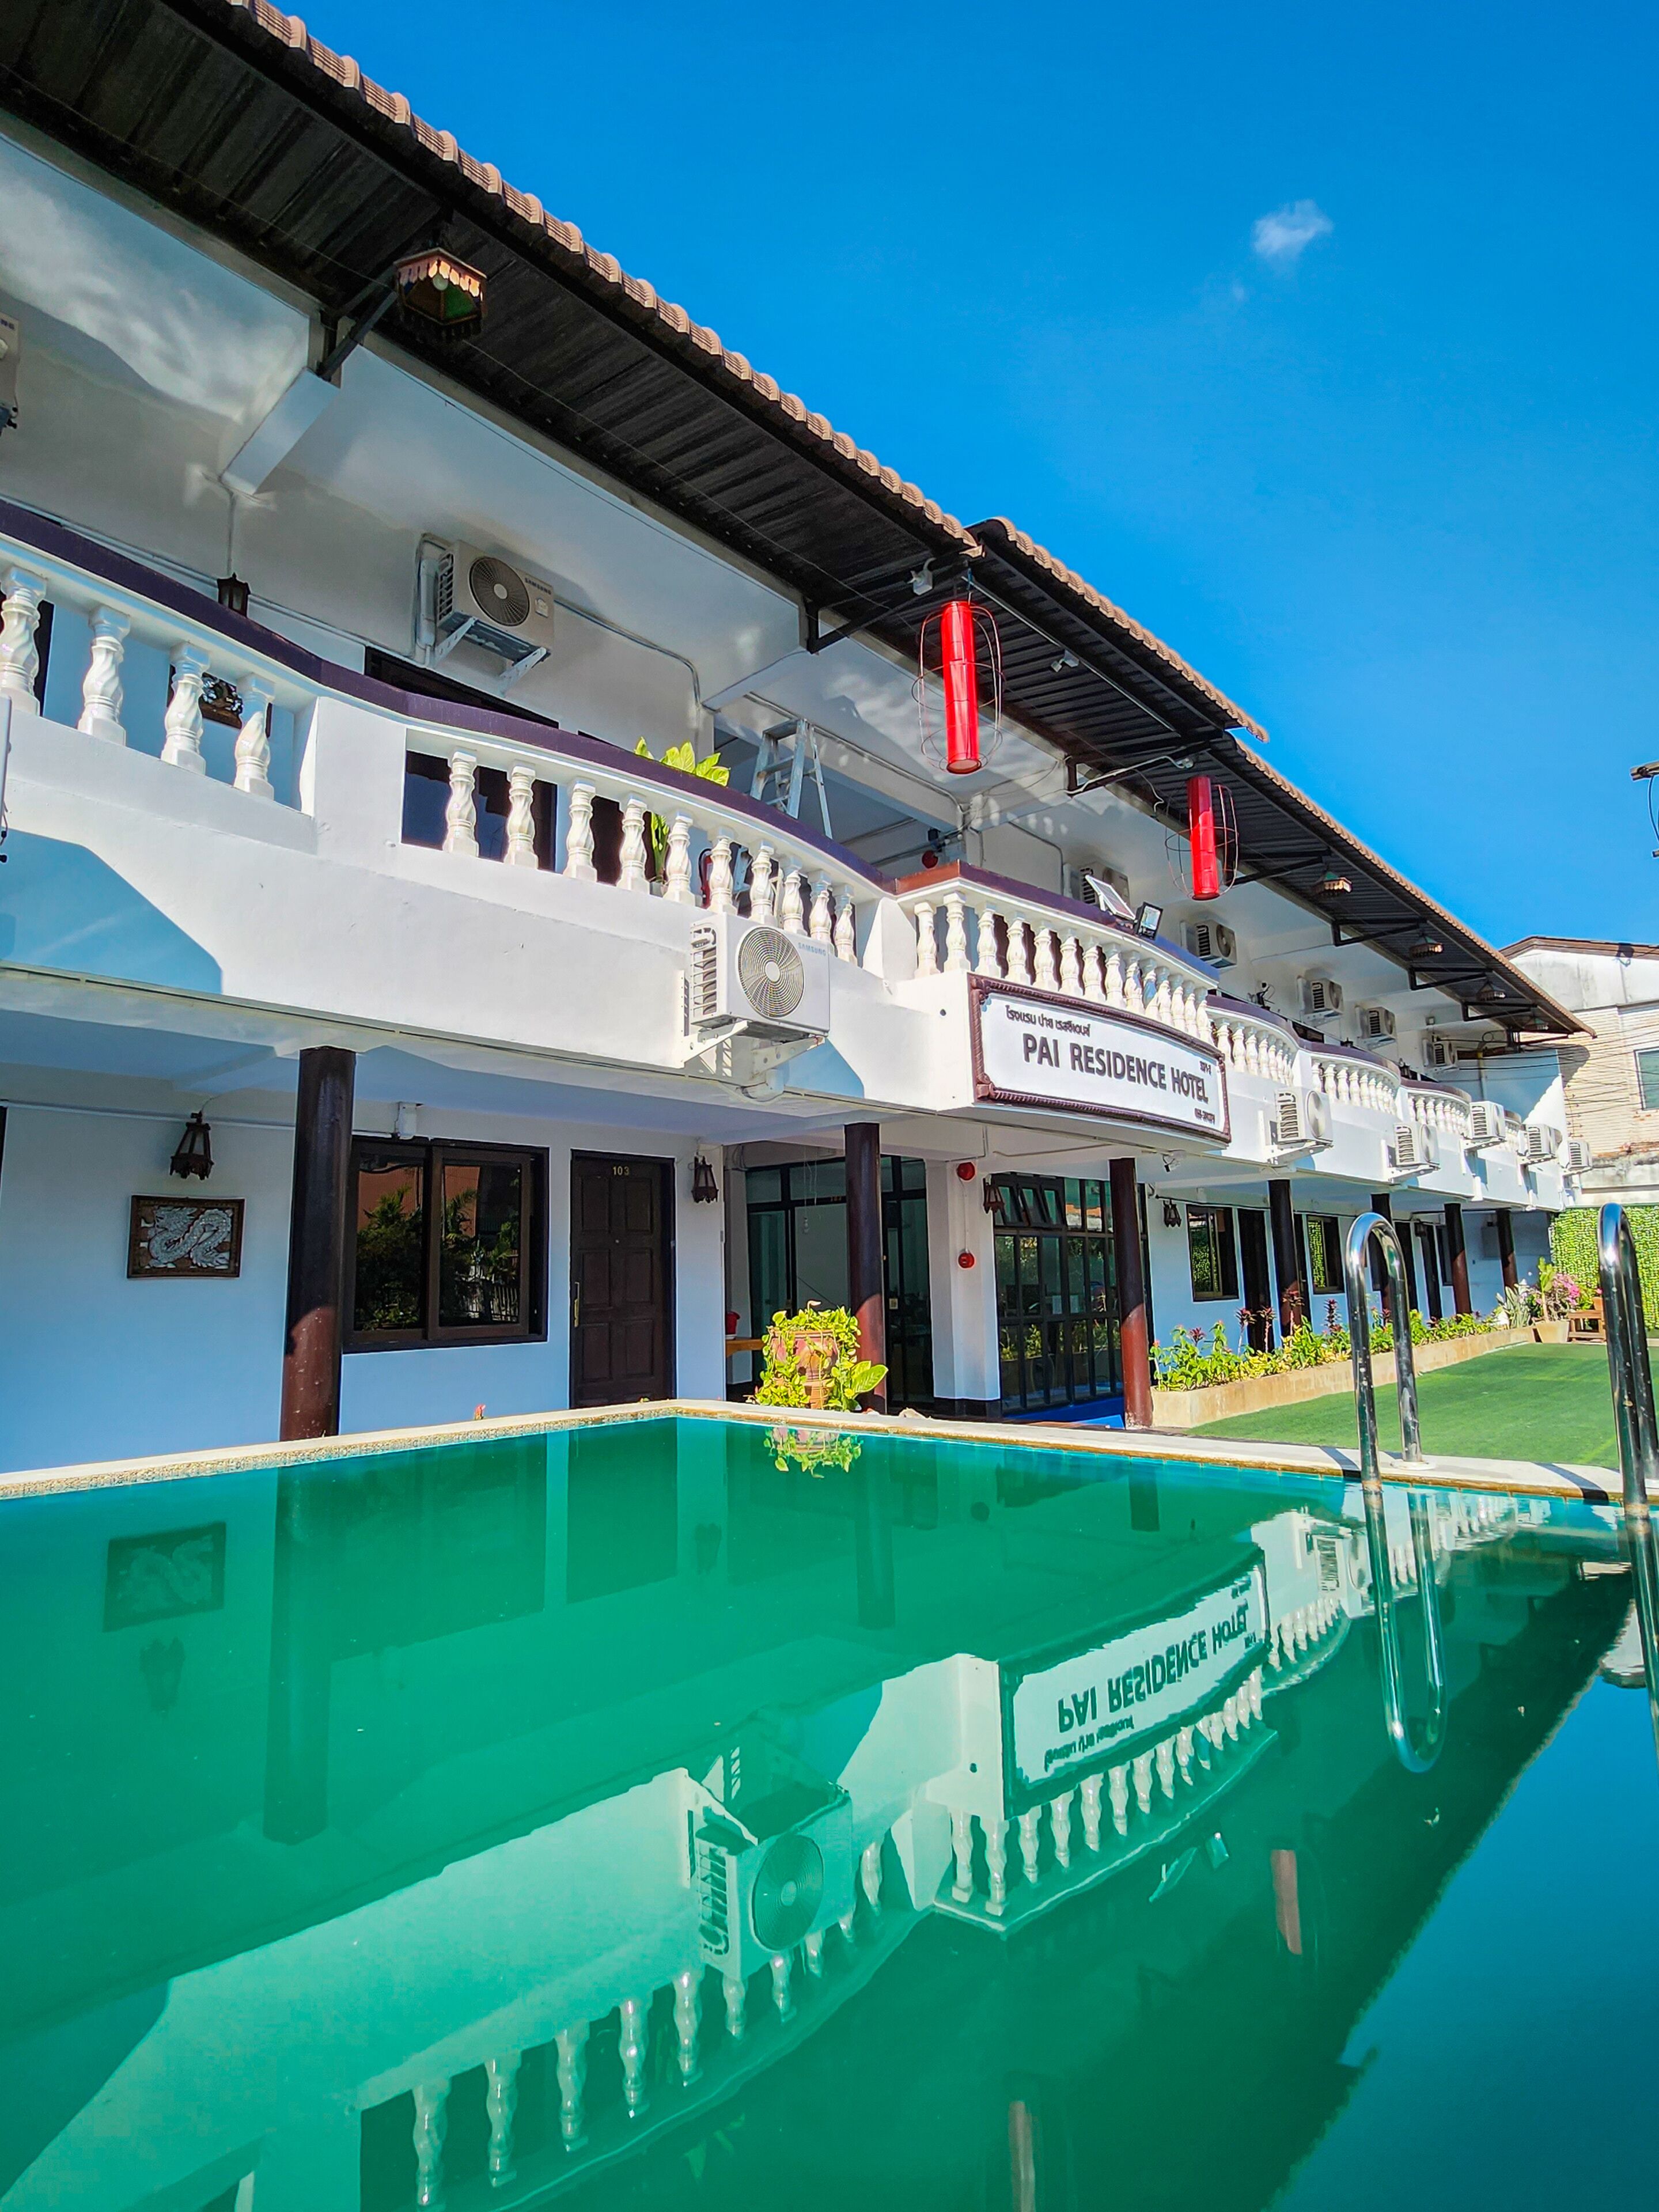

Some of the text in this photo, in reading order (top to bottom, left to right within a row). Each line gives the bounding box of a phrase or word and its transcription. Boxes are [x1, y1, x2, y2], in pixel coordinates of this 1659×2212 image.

[798, 942, 826, 956] SAMSUNG
[1022, 1033, 1209, 1104] PAI RESIDENCE HOTEL
[612, 1165, 630, 1176] 103
